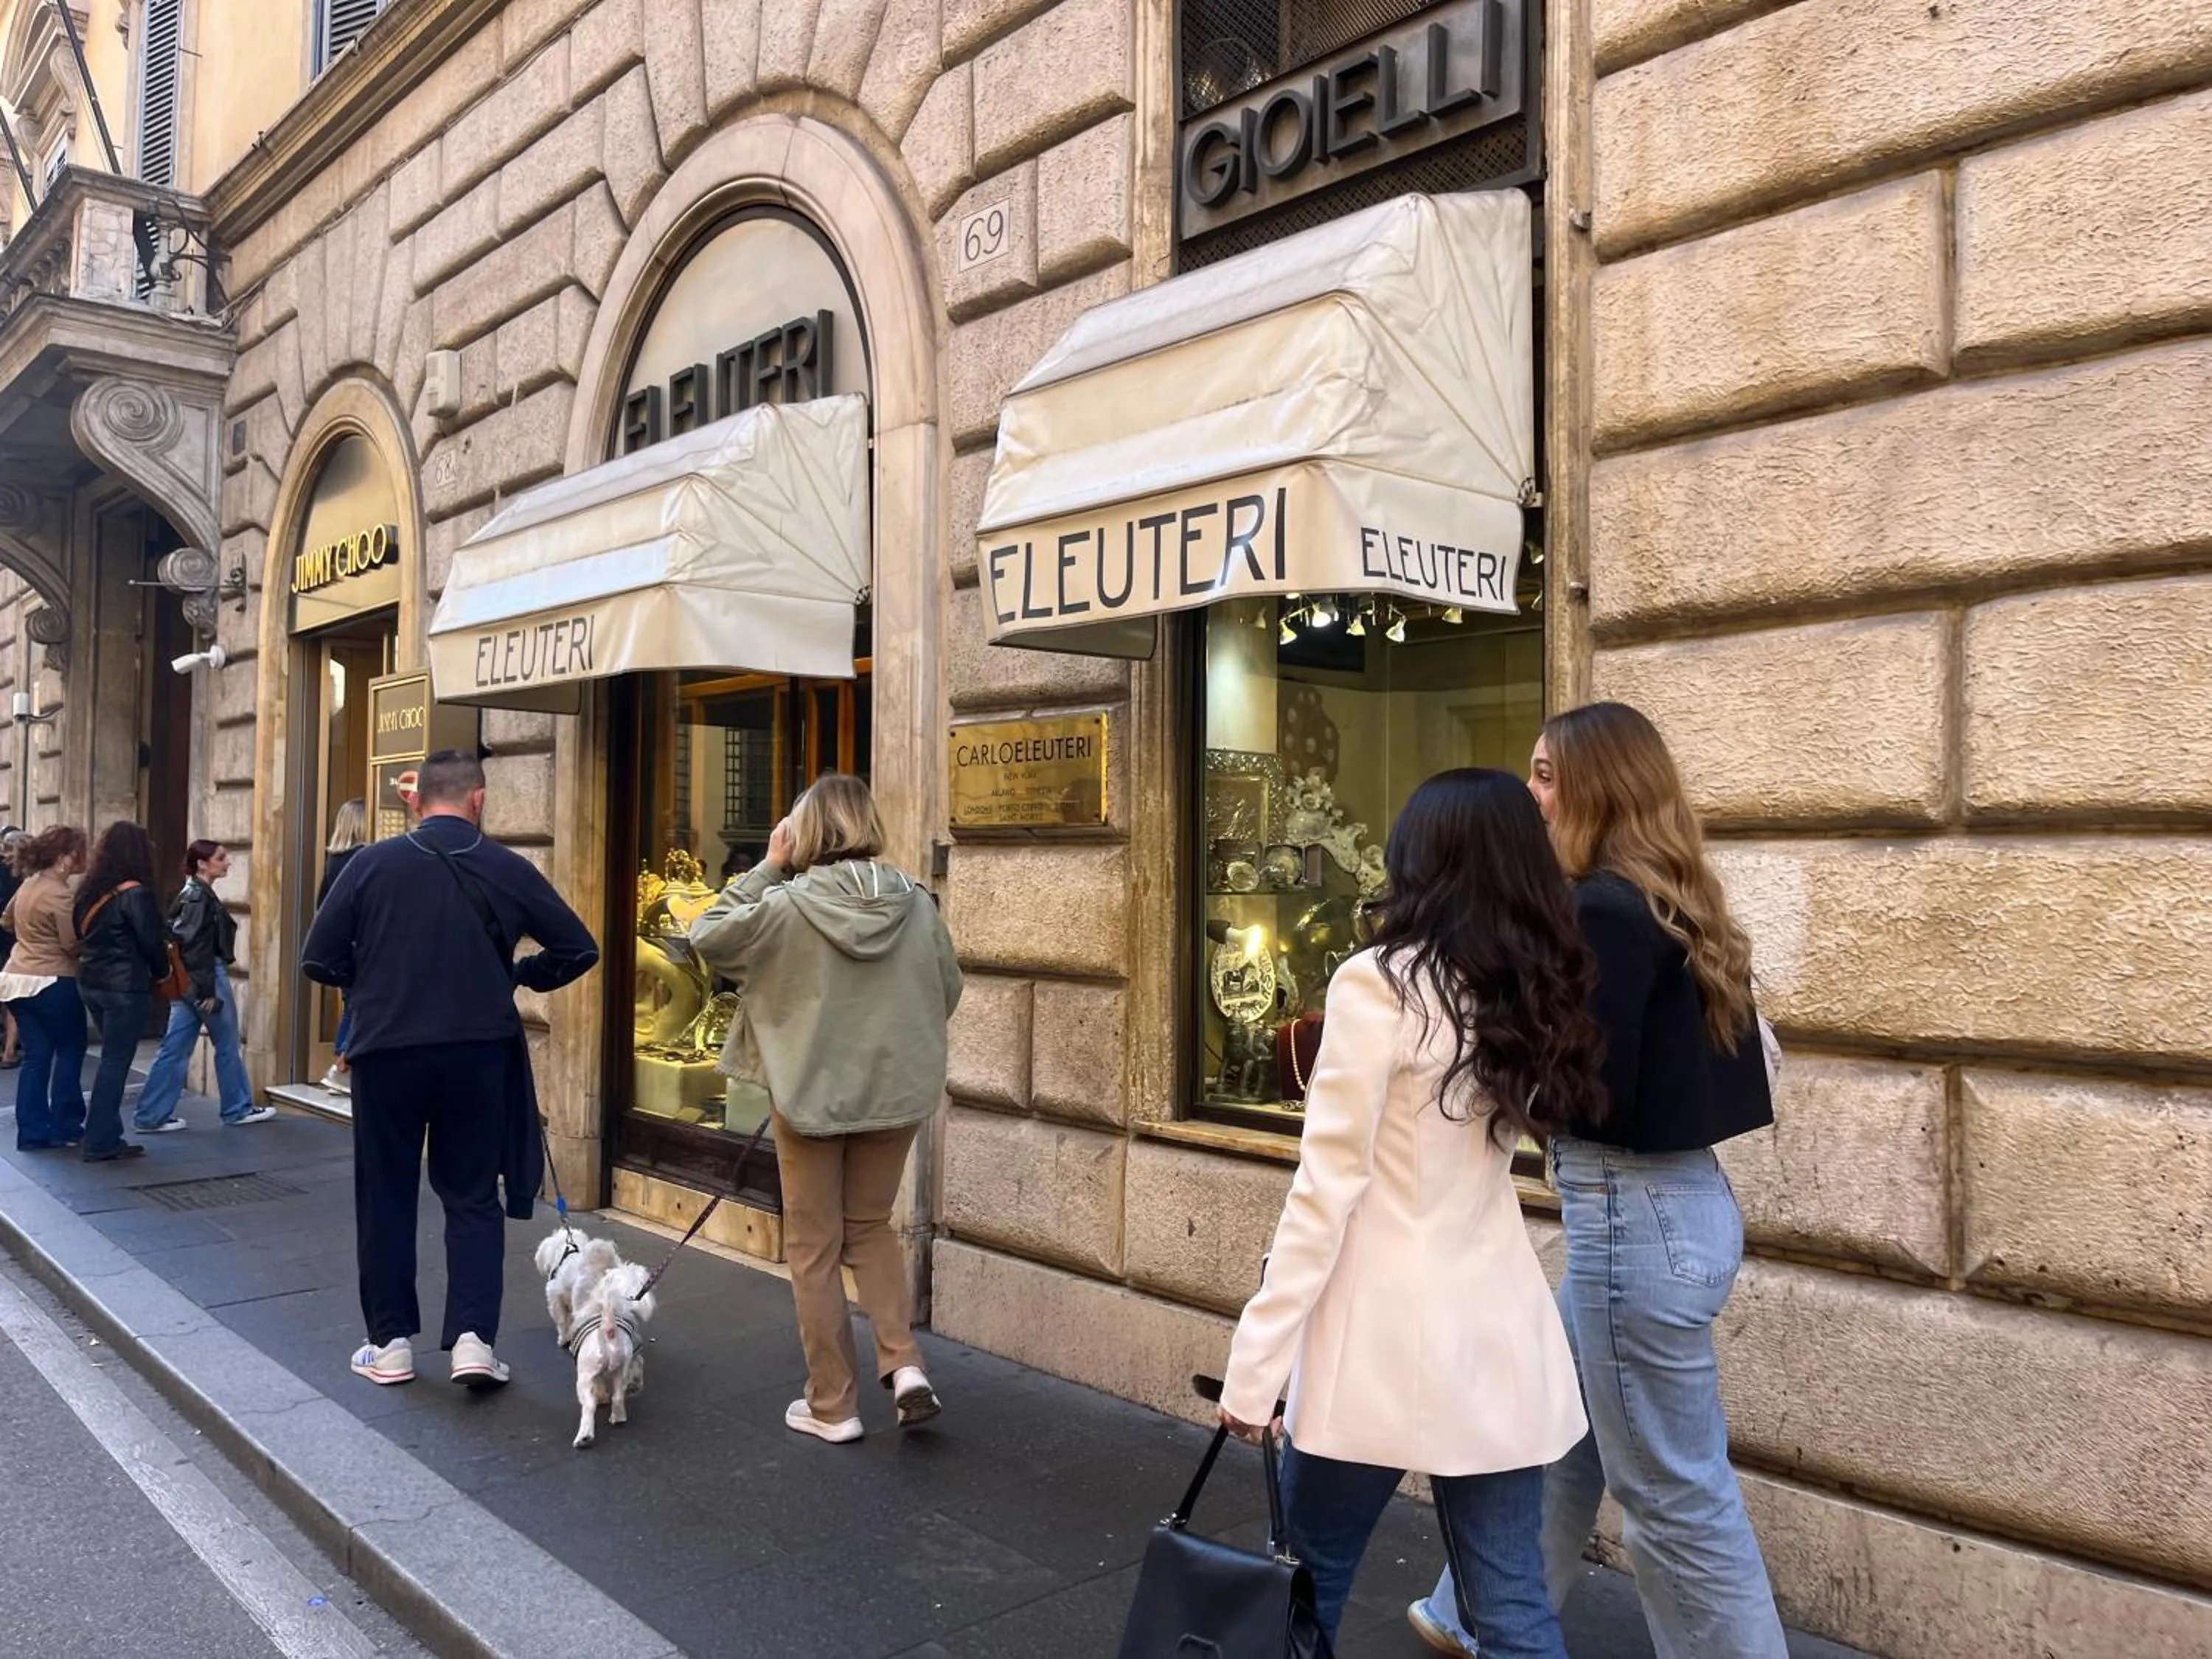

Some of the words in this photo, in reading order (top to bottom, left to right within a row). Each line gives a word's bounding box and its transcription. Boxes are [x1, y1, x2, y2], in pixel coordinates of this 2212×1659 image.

[1186, 1, 1500, 206] GIOIELLI
[965, 210, 1003, 260] 69
[291, 543, 332, 594] JIMMY
[335, 524, 386, 577] CHOO
[990, 487, 1286, 625] ELEUTERI
[1361, 527, 1506, 600] ELEUTERI
[476, 614, 594, 687] ELEUTERI
